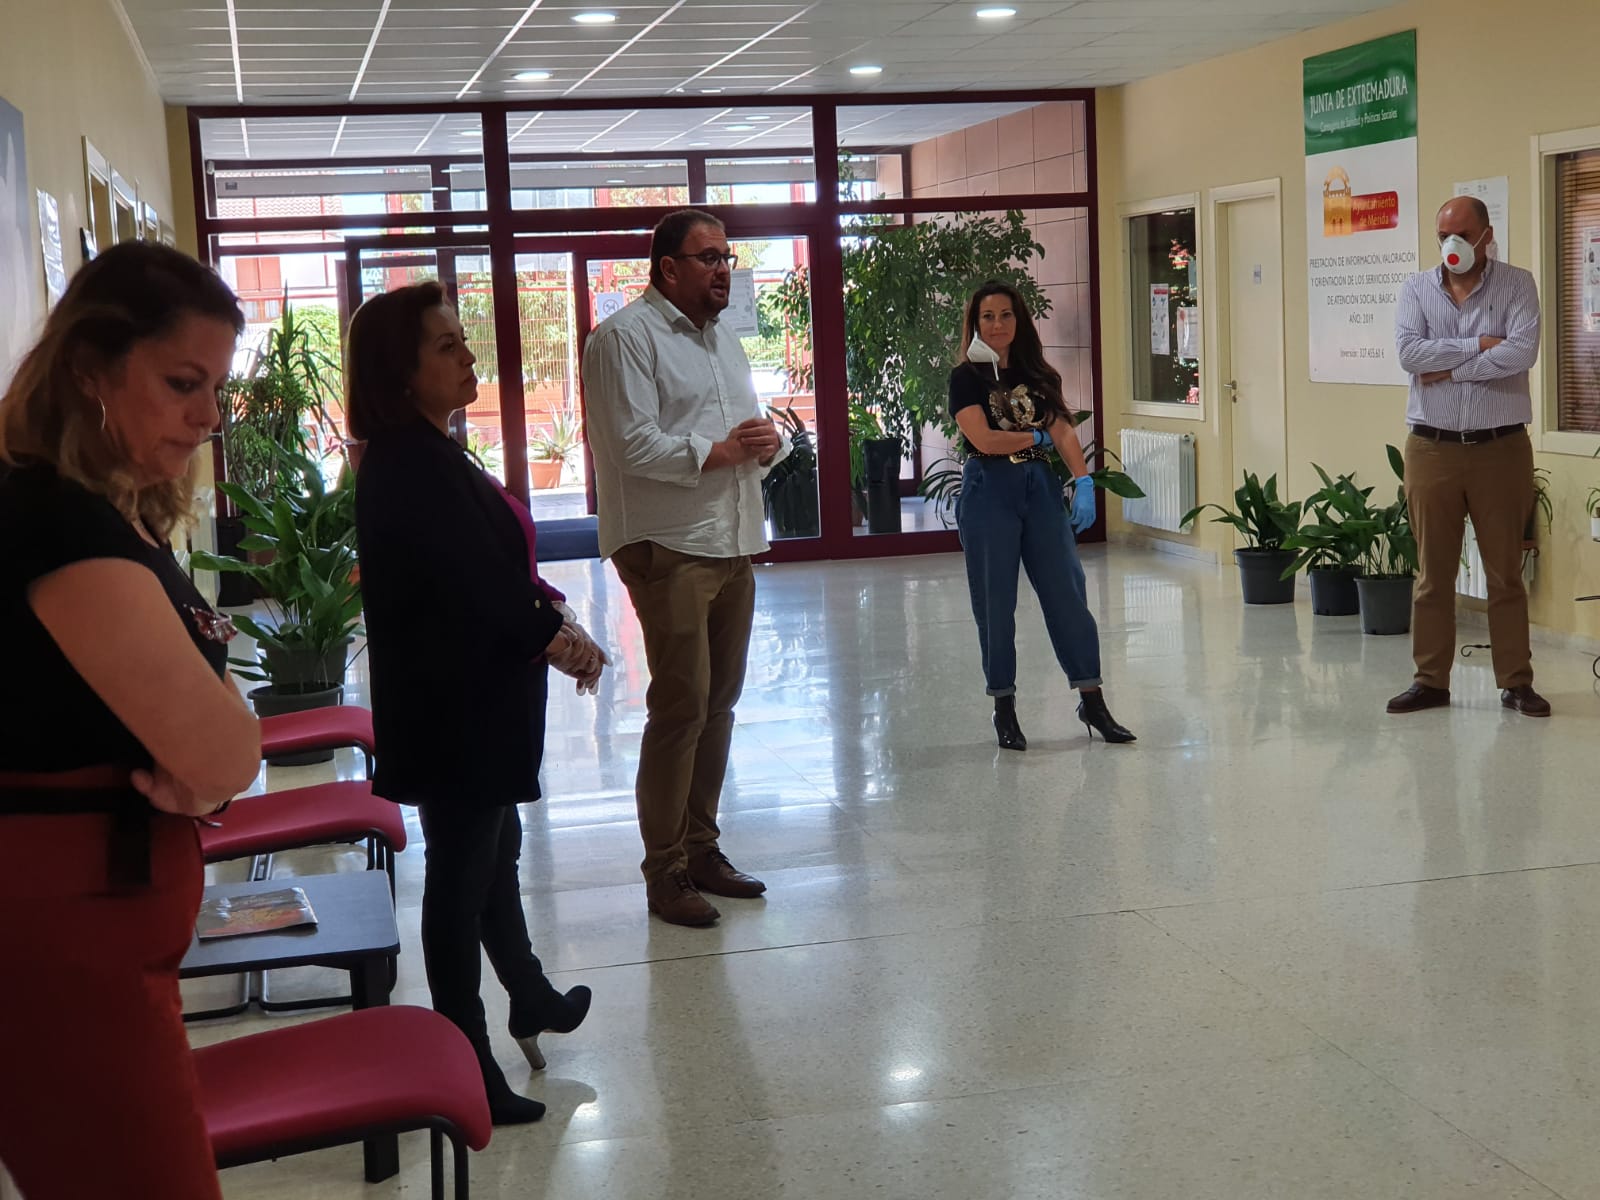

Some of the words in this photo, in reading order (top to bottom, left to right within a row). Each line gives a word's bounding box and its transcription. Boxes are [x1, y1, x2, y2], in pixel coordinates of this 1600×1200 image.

[1310, 91, 1334, 118] JUNTA
[1335, 88, 1345, 109] DE
[1347, 75, 1408, 106] EXTREMADURA
[1337, 256, 1345, 267] DE
[1347, 274, 1354, 286] DE
[1355, 273, 1365, 285] LOS
[1365, 273, 1390, 285] SERVICIOS
[1327, 294, 1334, 306] DE
[1359, 293, 1378, 305] SOCIAL
